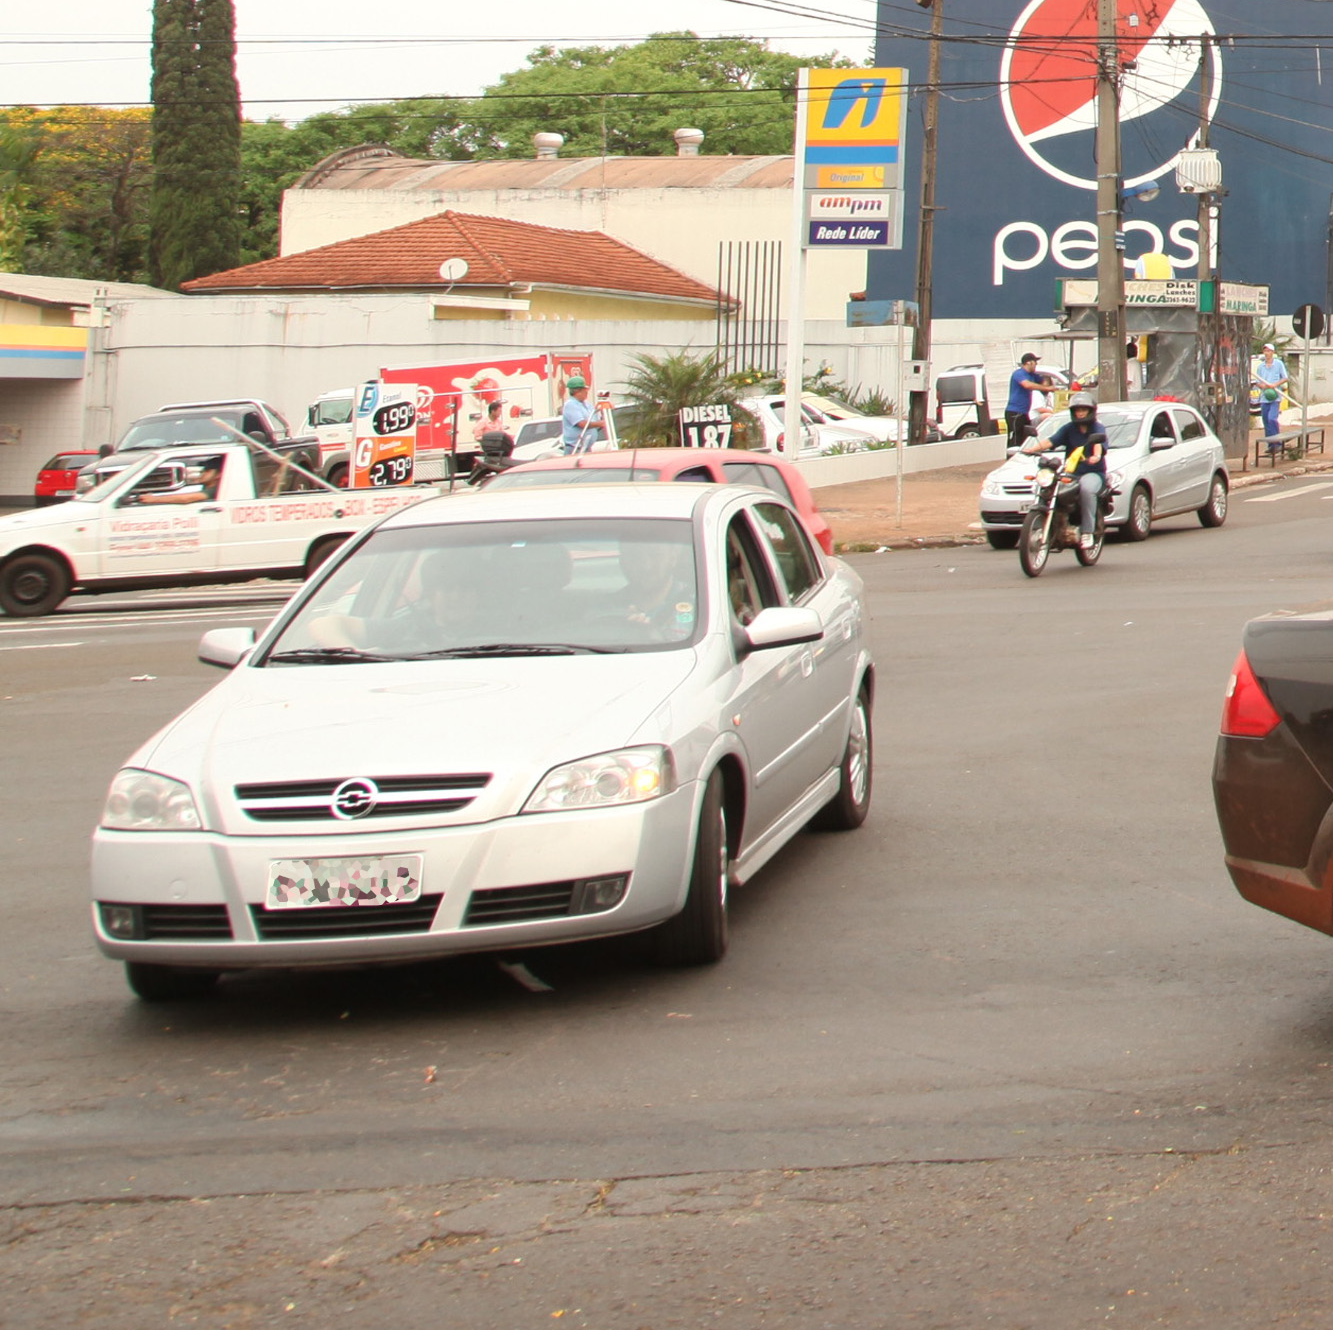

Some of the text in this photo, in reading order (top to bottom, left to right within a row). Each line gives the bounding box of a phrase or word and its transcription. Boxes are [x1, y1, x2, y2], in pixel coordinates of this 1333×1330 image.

[830, 173, 865, 183] Original
[816, 226, 881, 240] Rede Líder
[682, 404, 732, 423] DIESEL
[356, 438, 374, 468] G
